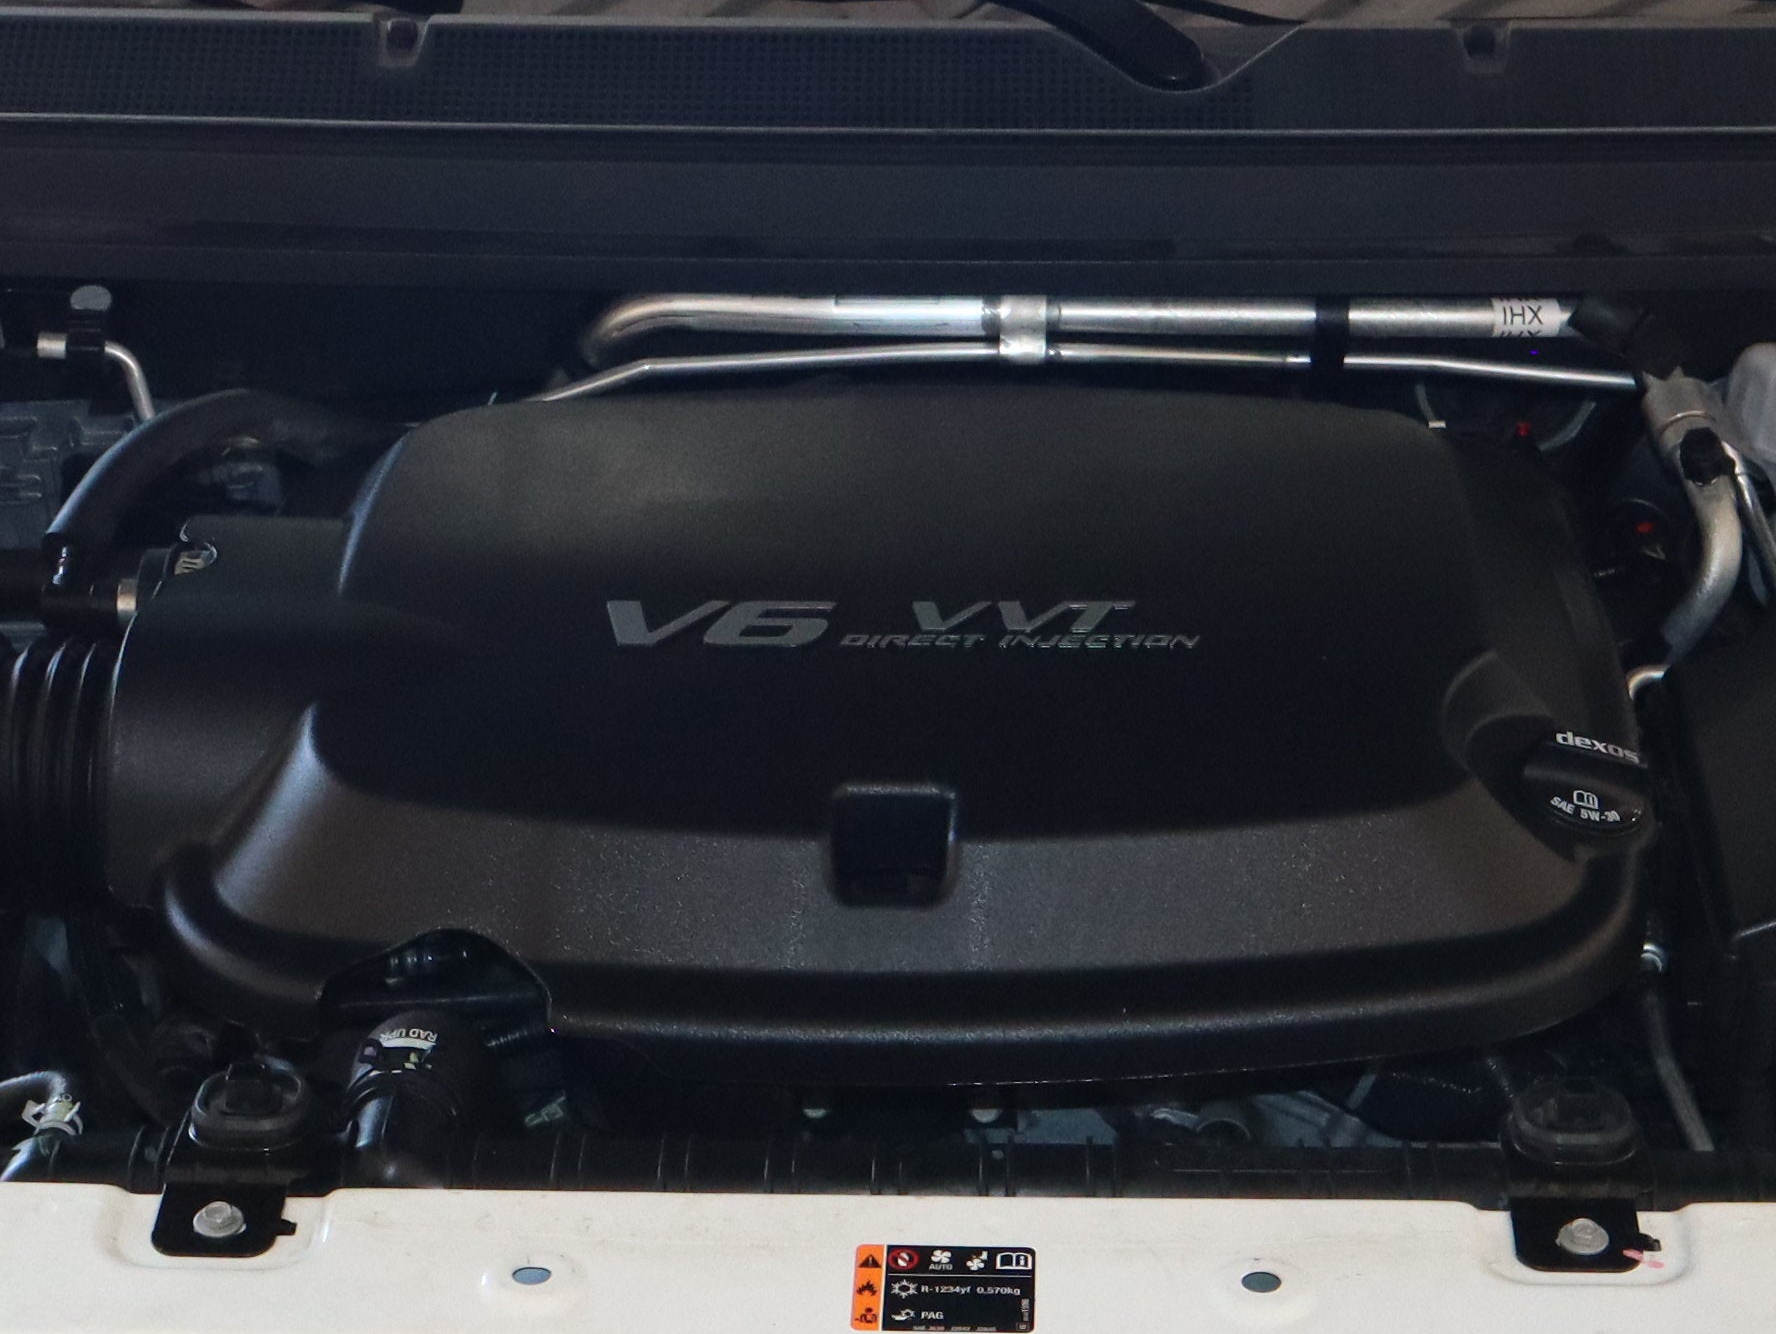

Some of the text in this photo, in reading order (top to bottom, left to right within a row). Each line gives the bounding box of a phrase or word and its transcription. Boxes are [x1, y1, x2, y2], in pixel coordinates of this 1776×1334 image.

[1502, 305, 1543, 325] IHX
[606, 599, 1136, 647] V6 VVT
[840, 633, 1202, 649] DIRECT INJECTION
[1555, 731, 1640, 763] dexos
[1550, 796, 1621, 822] SAE 5W-30
[409, 1028, 438, 1043] RAD
[921, 1285, 1021, 1295] R-1234yf 0.570kg
[921, 1311, 944, 1320] PAG
